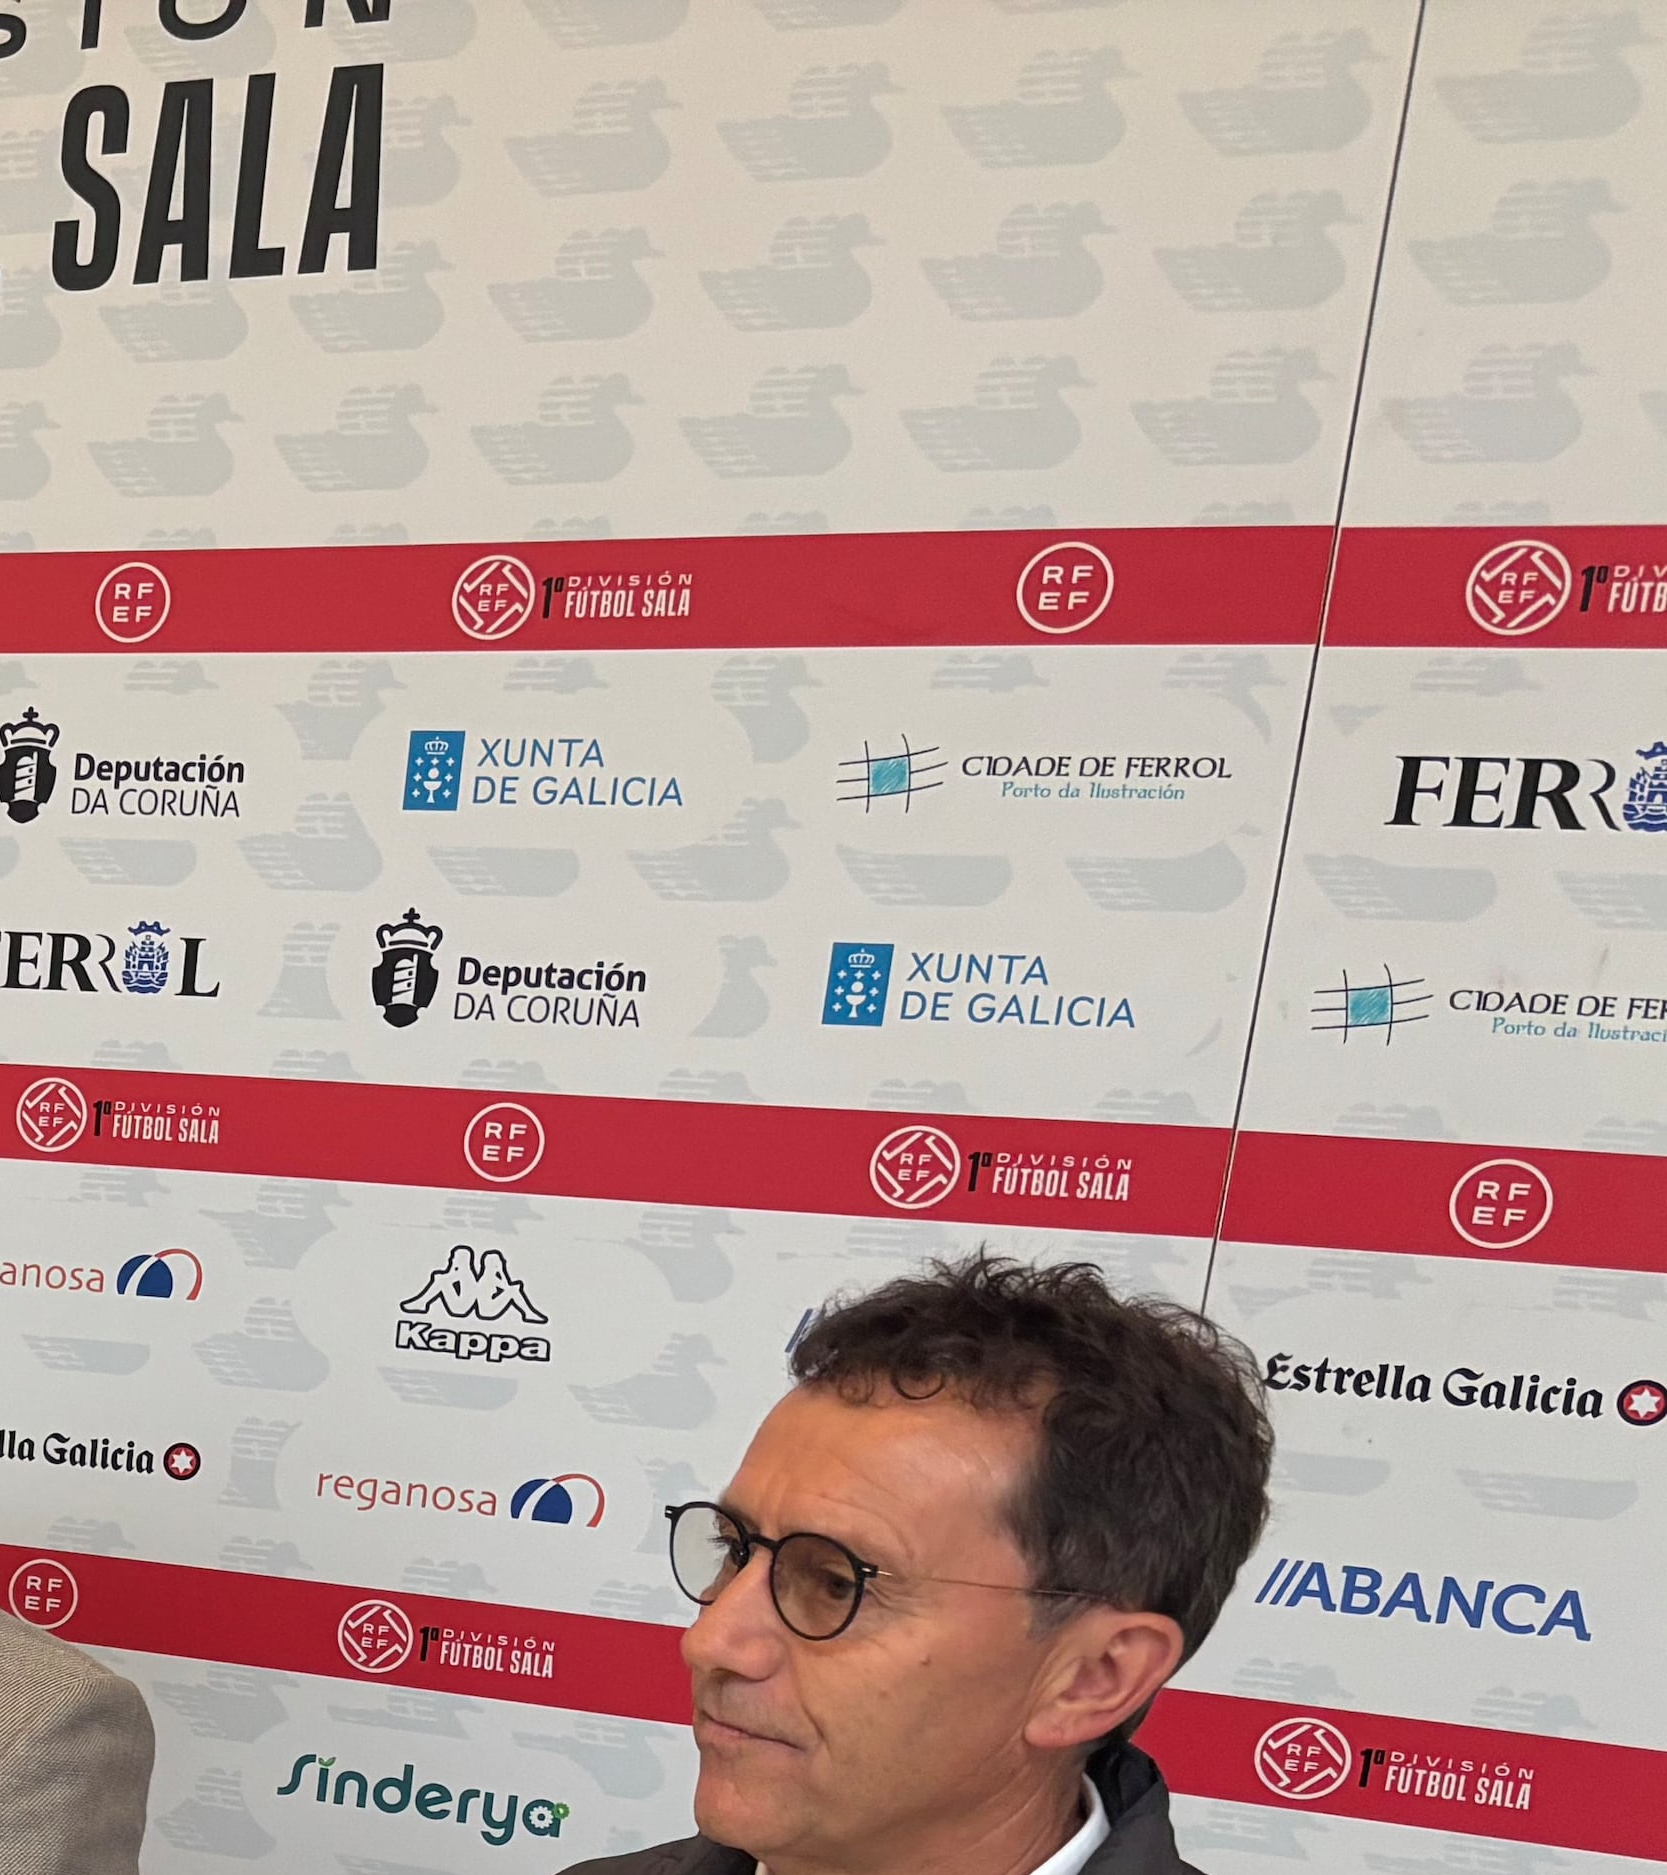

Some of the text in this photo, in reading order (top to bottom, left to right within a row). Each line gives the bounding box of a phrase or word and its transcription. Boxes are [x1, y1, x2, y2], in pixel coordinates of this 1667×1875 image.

[52, 63, 384, 291] SALA
[569, 571, 692, 590] DIVISIÓN
[565, 587, 690, 618] FÚTBOL SALA
[478, 739, 603, 767] XUNTA
[963, 756, 1231, 778] CIDADE DE FERROL
[75, 753, 244, 789] Deputación
[72, 777, 239, 817] DA CORUÑA
[473, 776, 682, 806] DE GALICIA
[1002, 781, 1051, 797] Porto
[1059, 782, 1080, 798] da
[456, 957, 645, 1000] Deputación
[907, 953, 1048, 985] XUNTA
[454, 993, 639, 1027] DA CORUÑA
[901, 991, 1134, 1028] DE GALICIA
[1449, 990, 1617, 1017] CIDADE DE
[1492, 1017, 1577, 1038] Porto da
[113, 1115, 218, 1143] FÚTBOL SALA
[114, 1102, 219, 1123] DIVISIÓN
[995, 1153, 1131, 1175] DIVISIÓN
[993, 1164, 1129, 1200] FÚTBOL SALA
[396, 1320, 550, 1362] Kappa
[1266, 1353, 1602, 1418] Estrella Galicia
[44, 1433, 153, 1474] Galicia
[318, 1474, 496, 1515] reganosa
[440, 1635, 552, 1678] FÚTBOL SALA
[441, 1629, 554, 1657] DIVISIÓN
[1385, 1756, 1530, 1809] FÚTBOL SALA
[1386, 1752, 1533, 1785] DIVISIÓN
[278, 1754, 562, 1845] Sinderya
